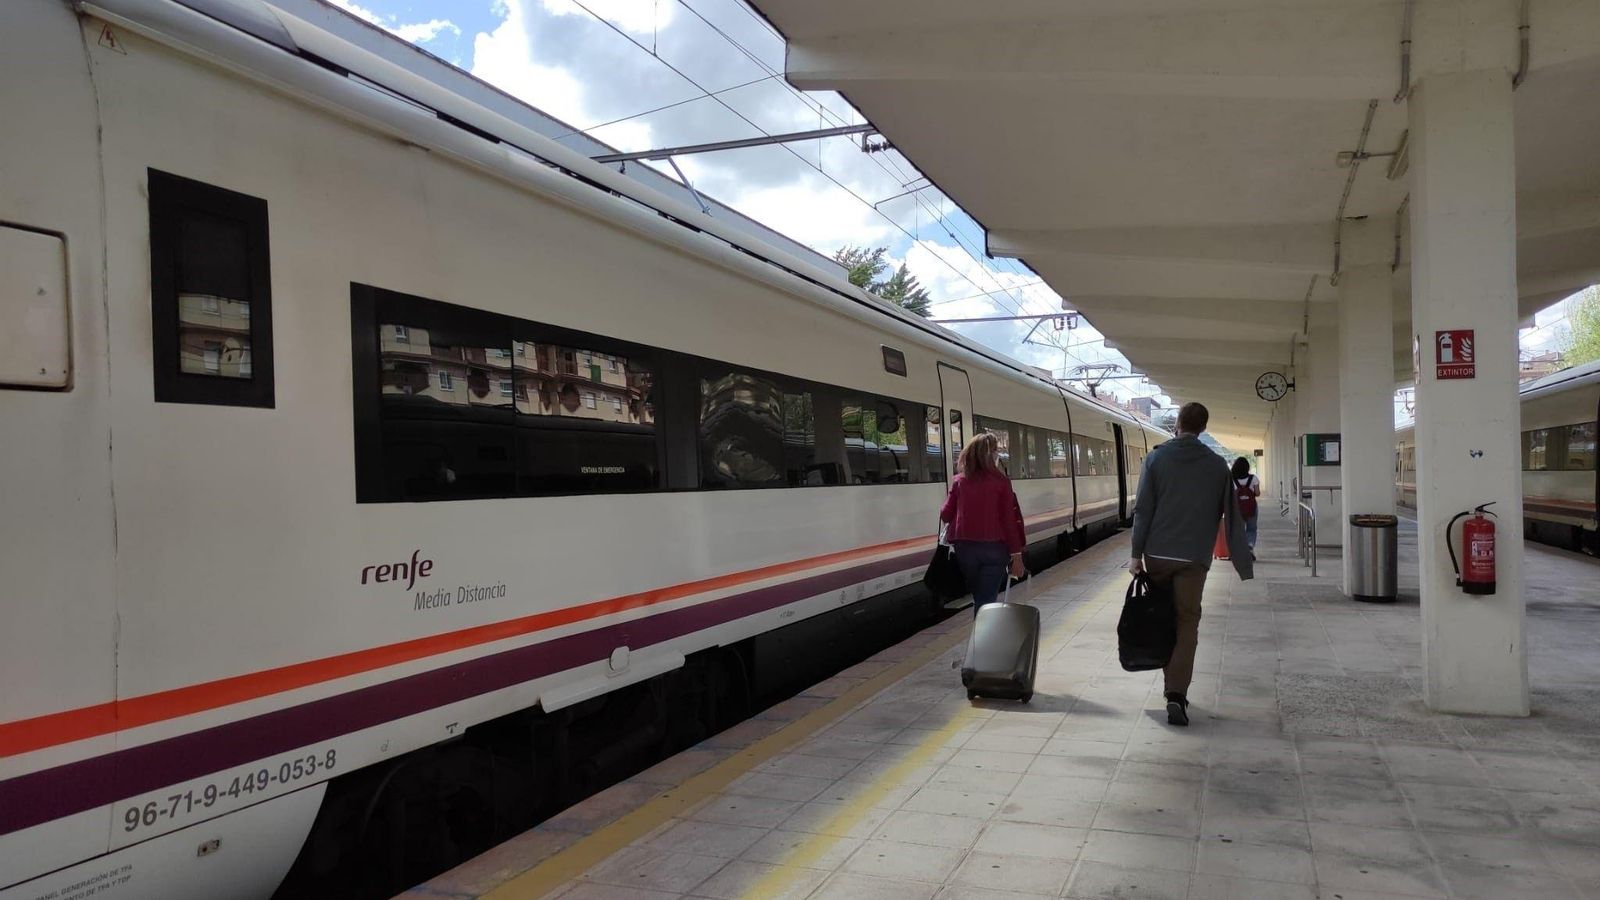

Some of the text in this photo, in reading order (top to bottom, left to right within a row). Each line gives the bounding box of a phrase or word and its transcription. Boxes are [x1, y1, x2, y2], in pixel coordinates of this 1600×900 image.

[1437, 367, 1474, 377] EXTINTOR
[361, 549, 433, 591] renfe
[414, 581, 506, 611] Media Distancia
[124, 749, 336, 832] 96-71-9-449-053-8
[109, 870, 118, 878] DE
